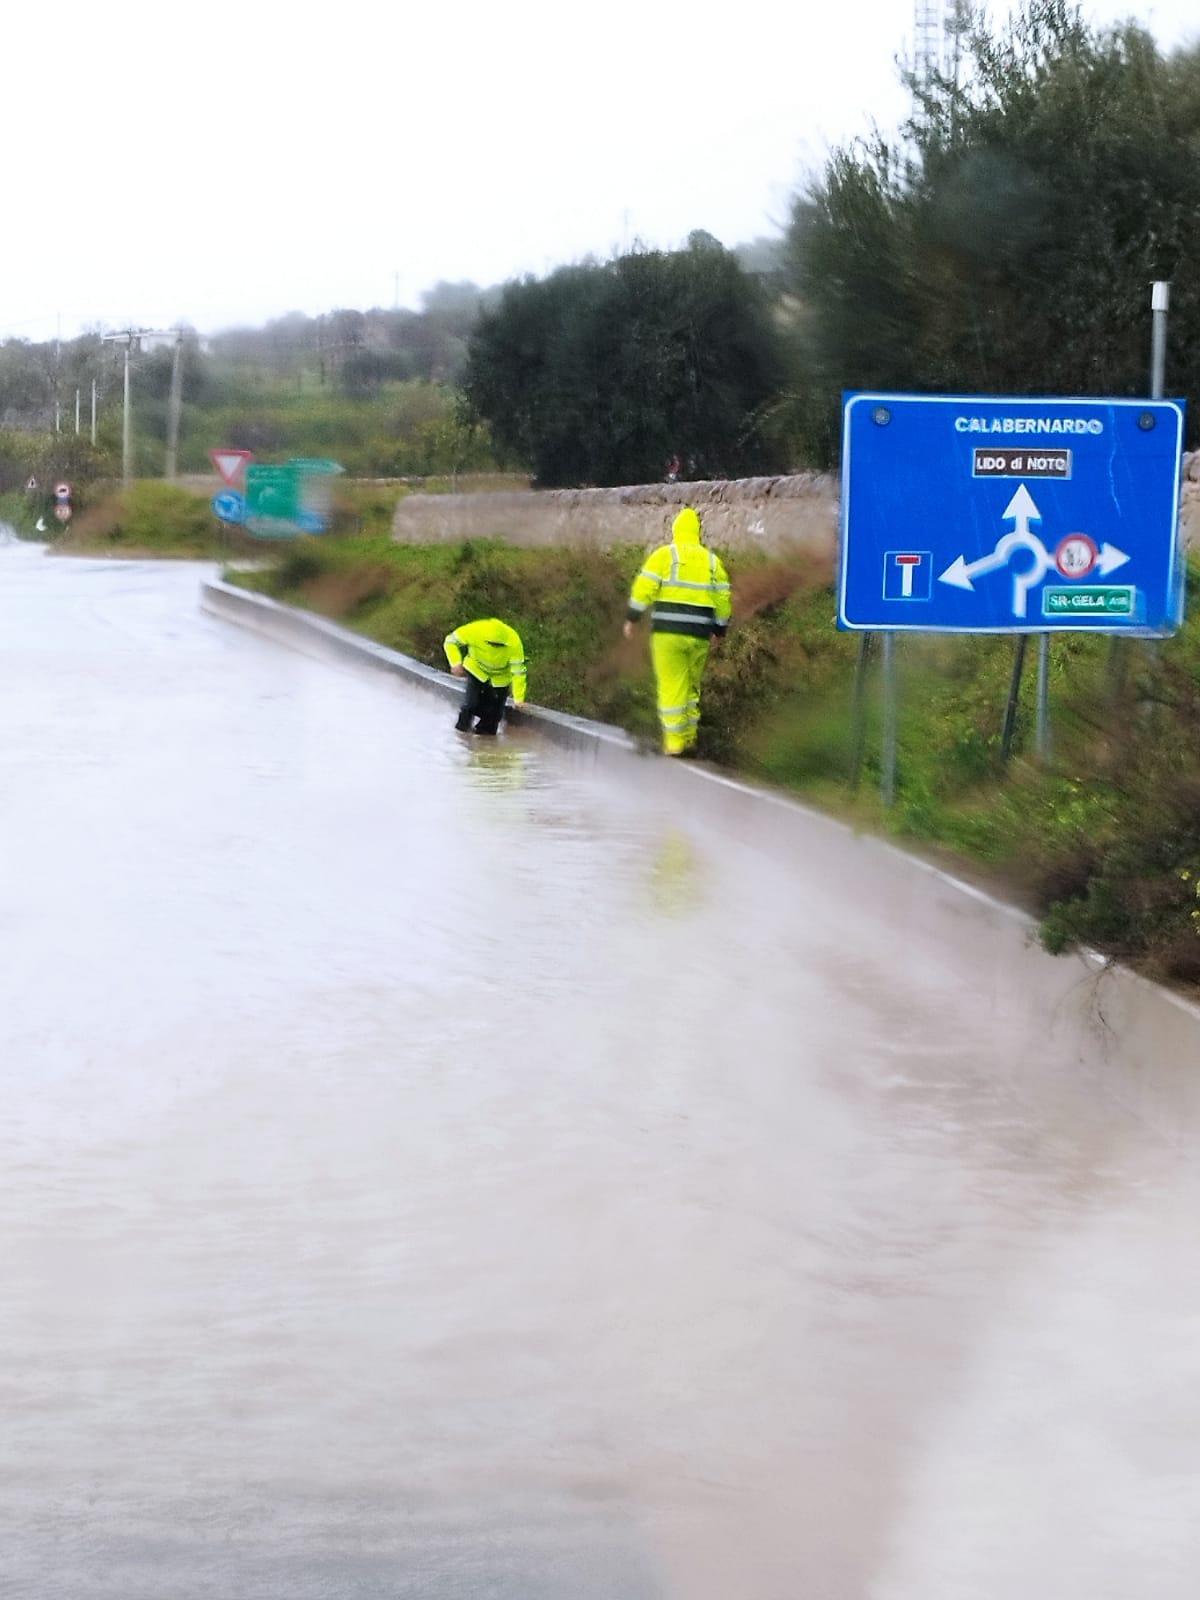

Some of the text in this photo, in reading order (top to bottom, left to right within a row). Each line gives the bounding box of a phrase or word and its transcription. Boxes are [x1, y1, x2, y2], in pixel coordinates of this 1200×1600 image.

[955, 416, 1104, 435] CALABERNARDO
[976, 457, 1067, 471] LIDO di NOTO
[1050, 595, 1105, 607] SR-GELA
